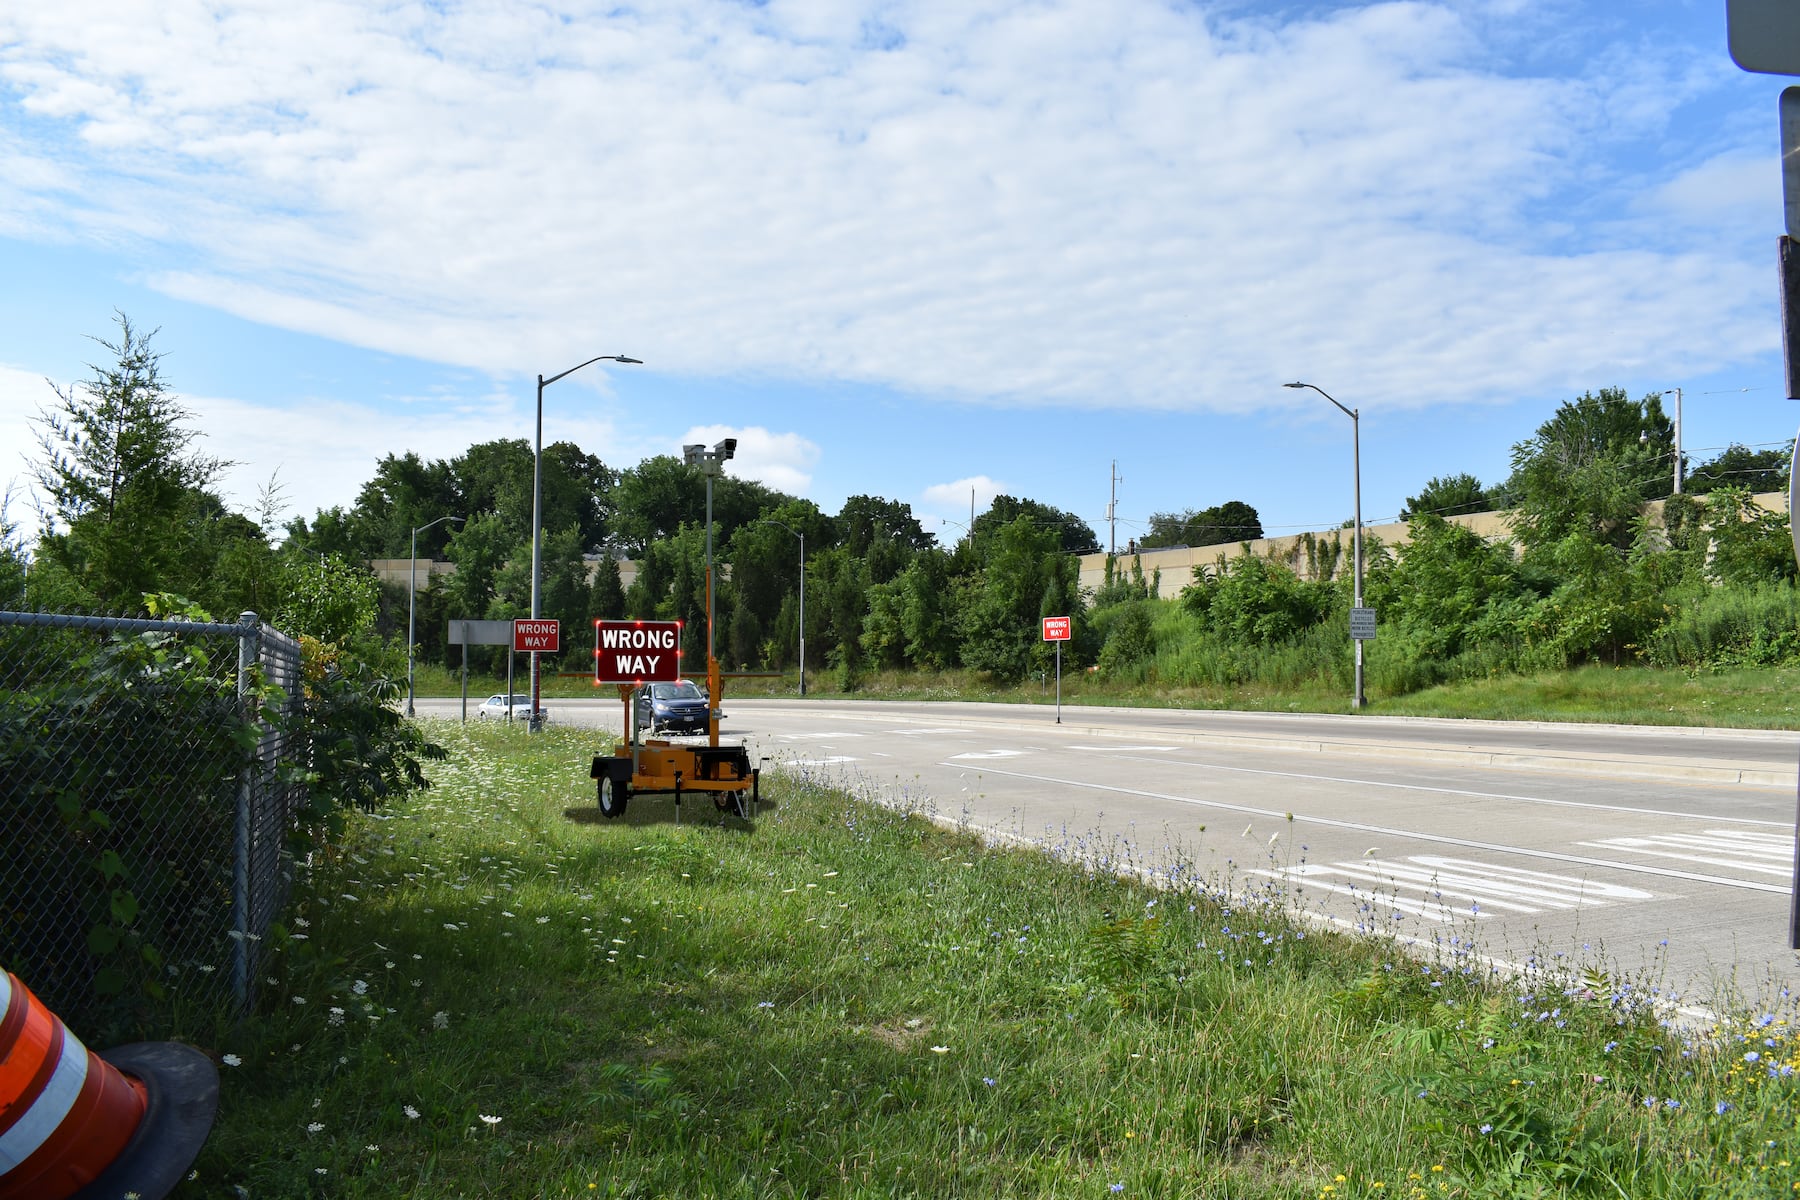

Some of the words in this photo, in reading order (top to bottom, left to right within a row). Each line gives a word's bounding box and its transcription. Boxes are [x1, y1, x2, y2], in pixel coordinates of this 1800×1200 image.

[517, 624, 556, 634] WRONG
[525, 637, 548, 647] WAY
[602, 629, 675, 649] WRONG
[616, 655, 660, 674] WAY
